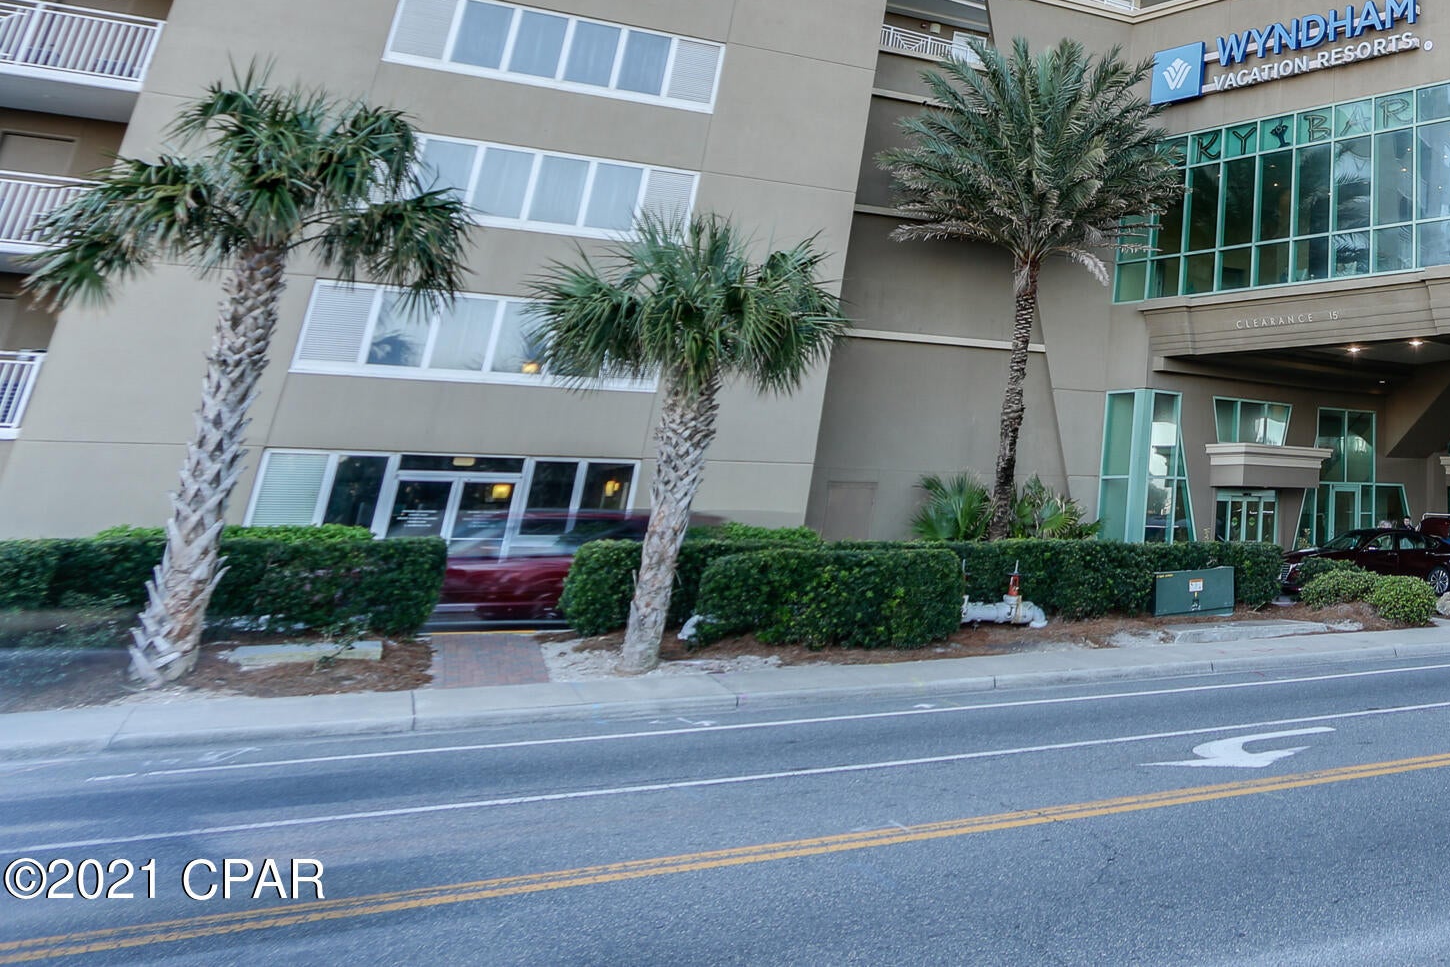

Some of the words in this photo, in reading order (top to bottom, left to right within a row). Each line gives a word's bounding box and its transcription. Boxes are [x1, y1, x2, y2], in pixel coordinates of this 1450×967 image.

[1213, 55, 1310, 91] VACATION
[1317, 32, 1416, 67] RESORTS
[1304, 98, 1413, 143] BAR
[1235, 313, 1314, 330] CLEARANCE
